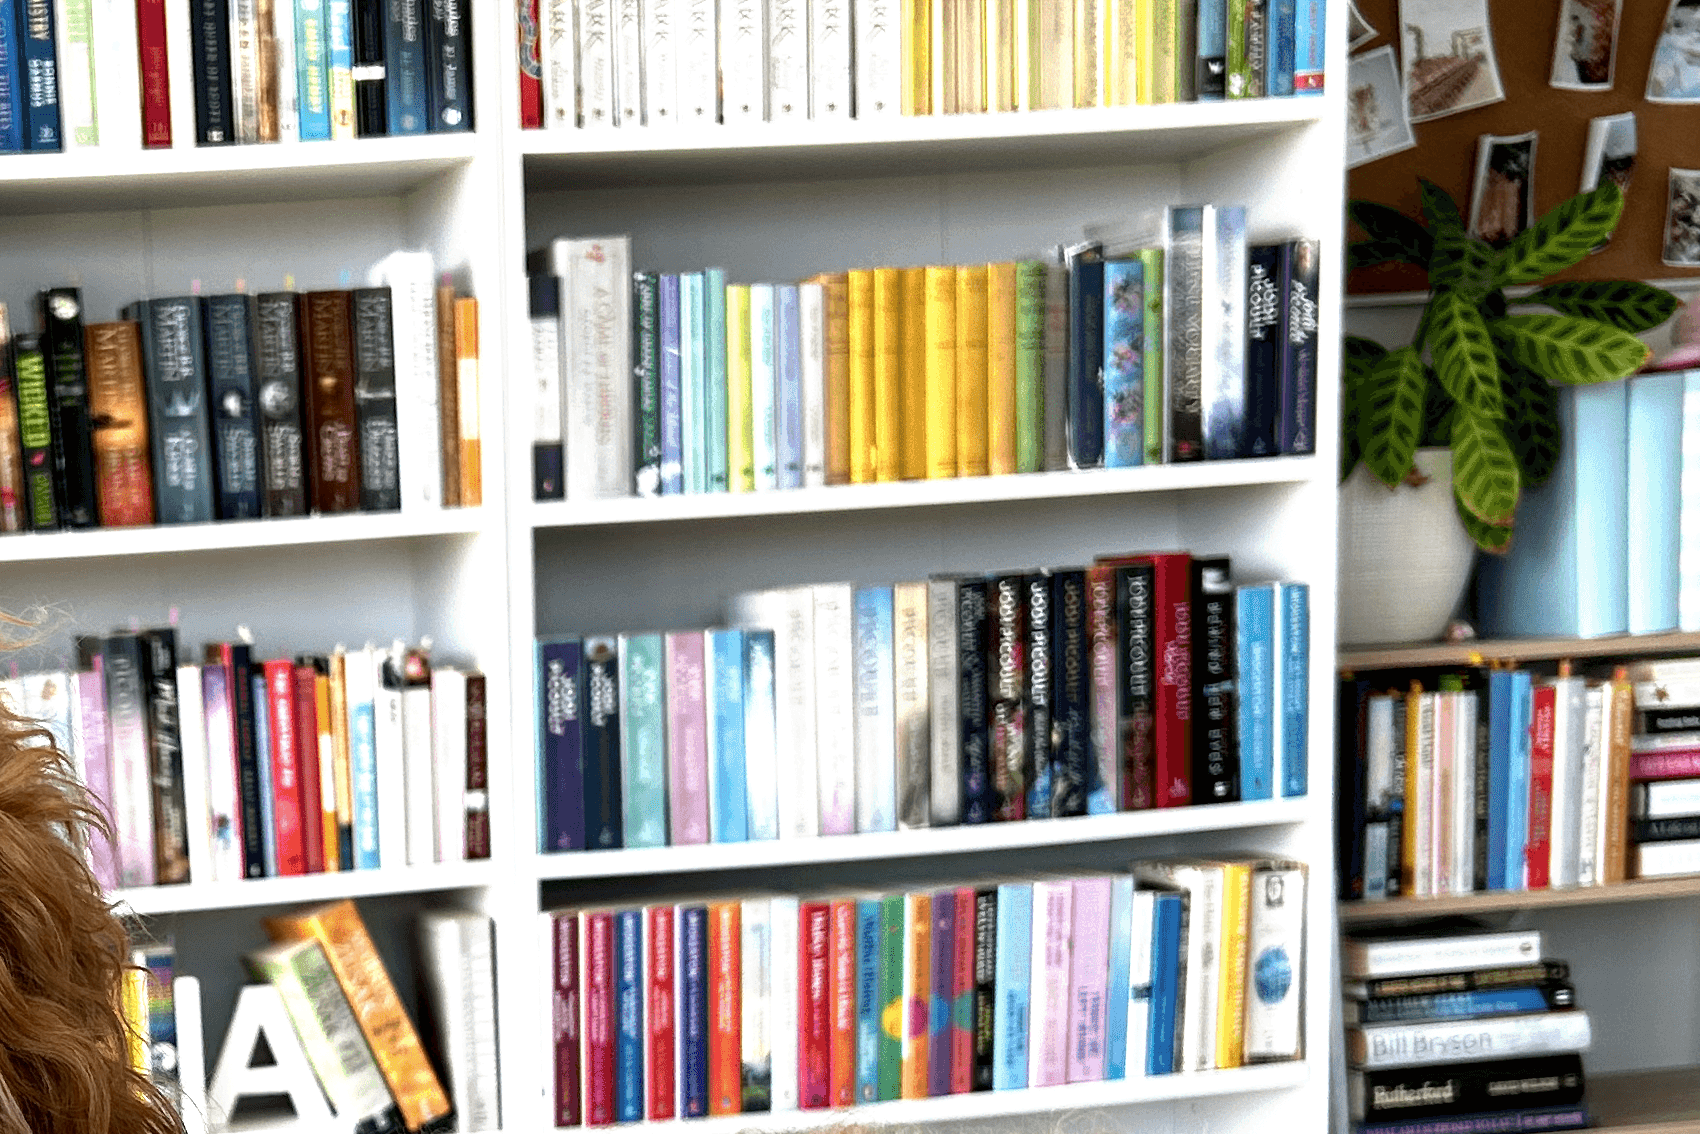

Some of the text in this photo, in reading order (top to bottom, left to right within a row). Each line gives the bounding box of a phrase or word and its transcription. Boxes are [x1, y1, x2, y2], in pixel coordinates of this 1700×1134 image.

[261, 302, 281, 378] MARTIN
[360, 297, 379, 373] MARTIN
[1248, 263, 1267, 340] PICOULT
[1262, 278, 1279, 325] JODI
[160, 304, 183, 383] MARTIN
[999, 581, 1018, 700] JODI PICOULT
[1031, 582, 1049, 706] JODI PICOULT
[1206, 602, 1224, 777] BEHIND HER EYES
[1373, 1032, 1493, 1062] Bill Bryson
